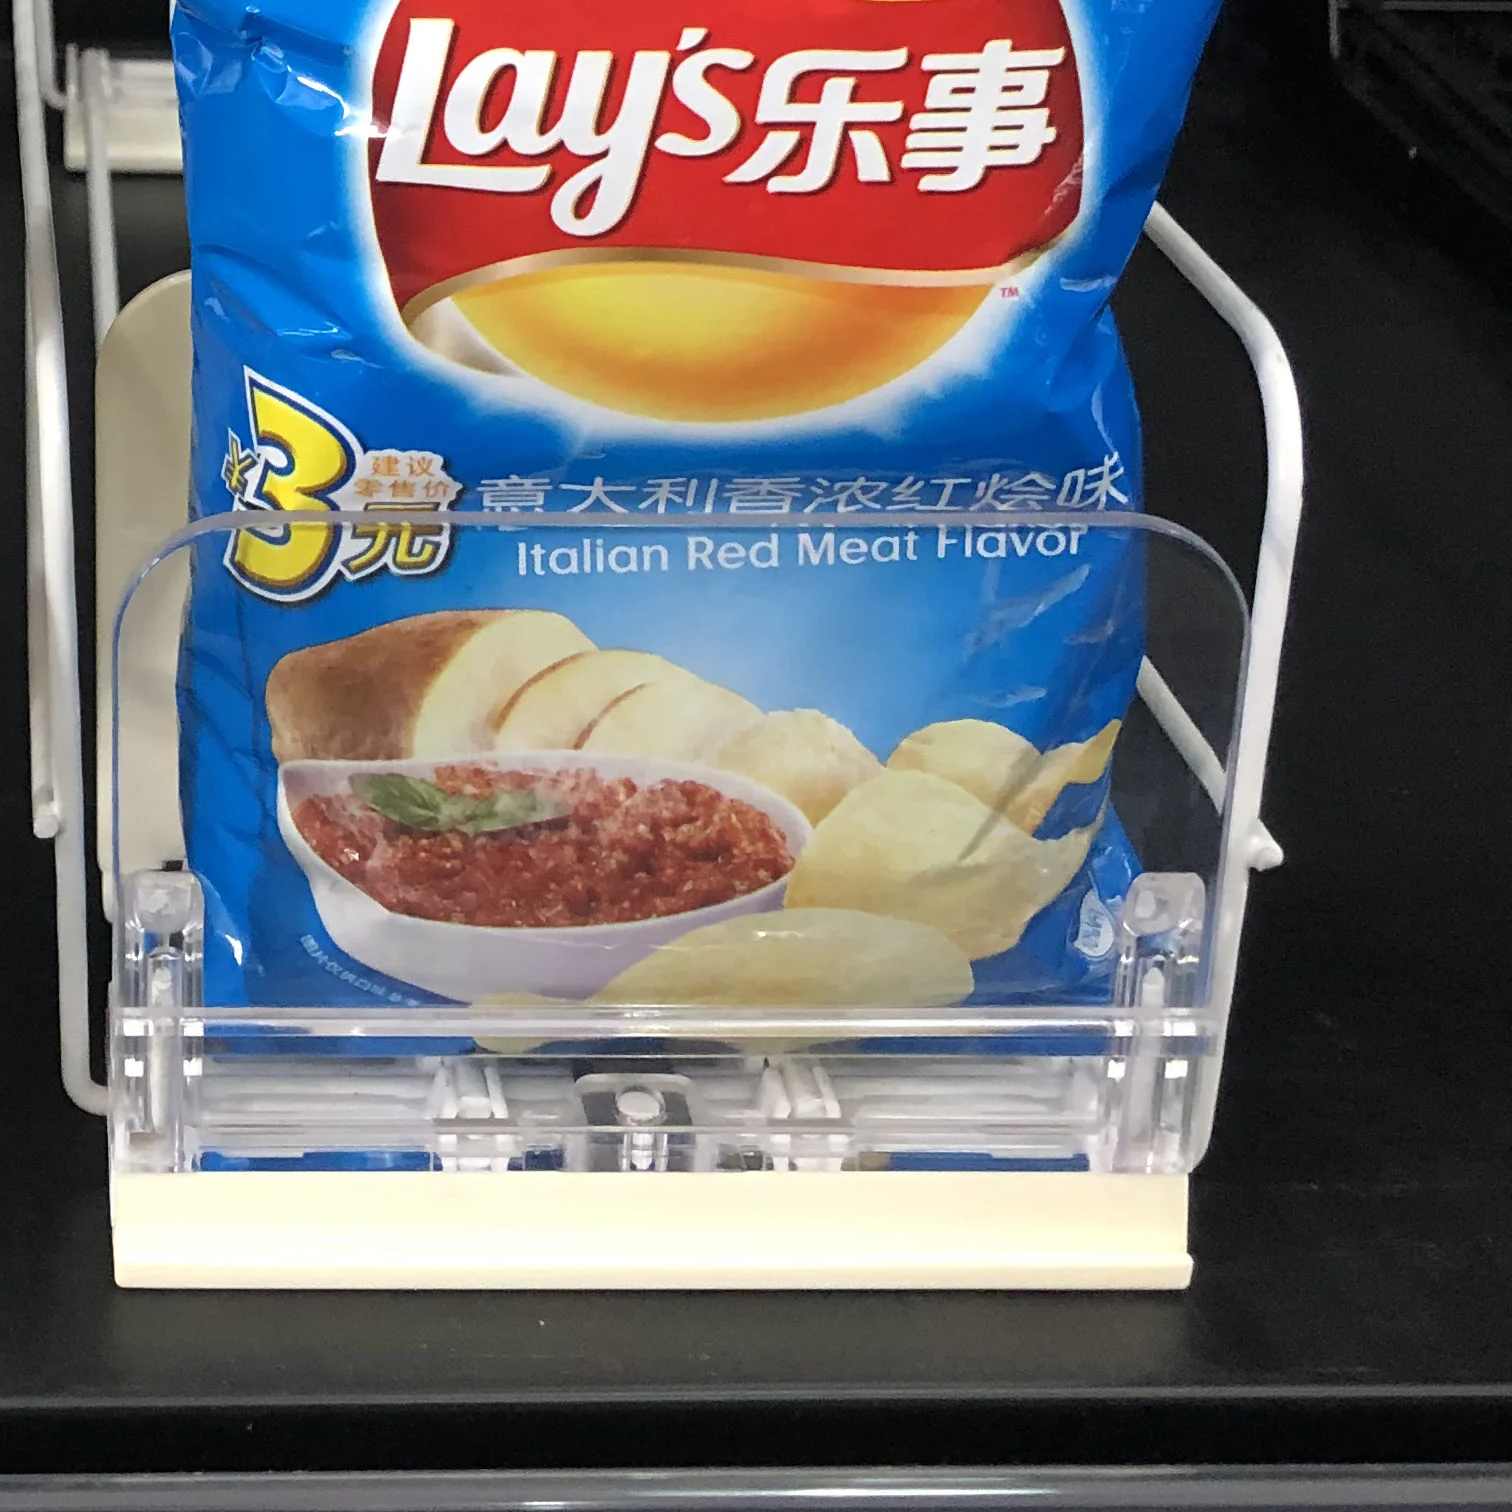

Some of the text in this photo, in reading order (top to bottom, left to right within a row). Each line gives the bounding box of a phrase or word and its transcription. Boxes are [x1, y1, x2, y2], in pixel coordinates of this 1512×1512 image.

[371, 455, 436, 477] 建议
[475, 451, 1129, 526] 意大利香浓红烩味
[517, 522, 1089, 577] Italian Red Meat Flavor
